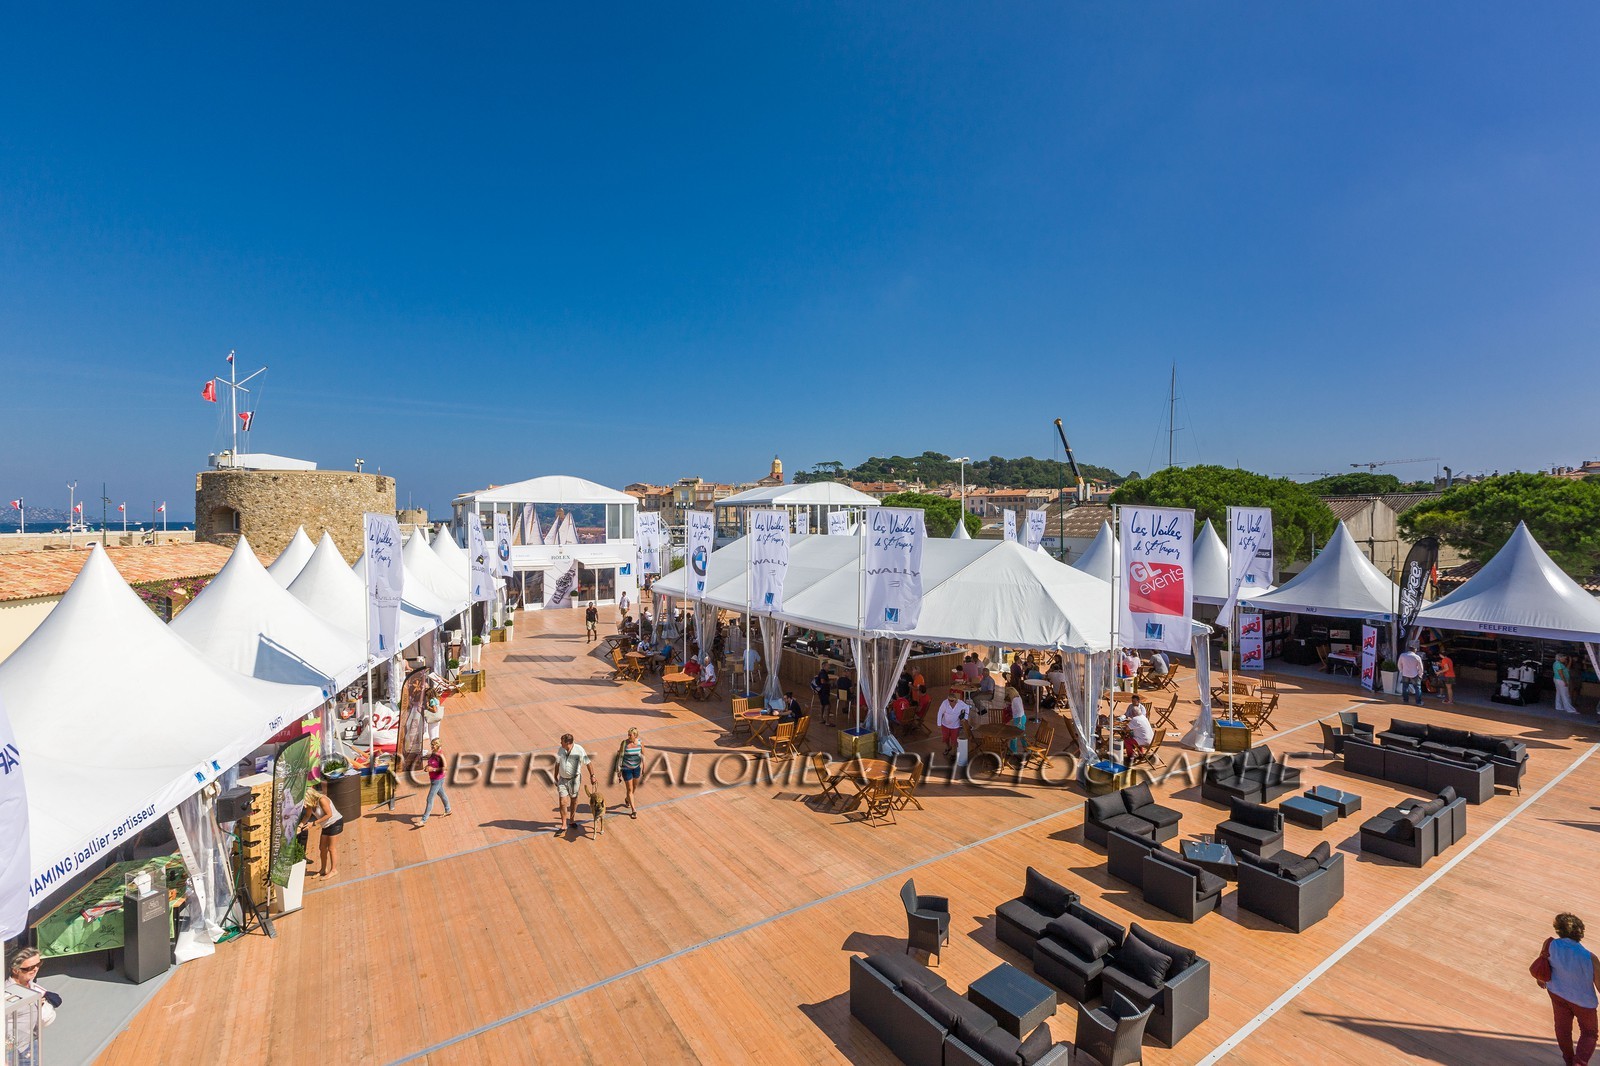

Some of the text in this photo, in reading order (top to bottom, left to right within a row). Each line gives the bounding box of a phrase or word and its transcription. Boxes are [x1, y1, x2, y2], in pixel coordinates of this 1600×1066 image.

[755, 513, 764, 531] Les
[766, 514, 785, 532] Voiles
[873, 511, 916, 536] Les Voiles
[1131, 511, 1182, 540] Les Voiles
[875, 537, 881, 547] de
[1133, 540, 1142, 551] de
[753, 558, 788, 567] WALLY
[867, 567, 920, 577] WALLY
[1130, 562, 1162, 582] GL
[1139, 567, 1184, 595] events
[1479, 623, 1518, 633] FEELFREE
[73, 833, 110, 870] joallier
[112, 803, 157, 841] sertisseur
